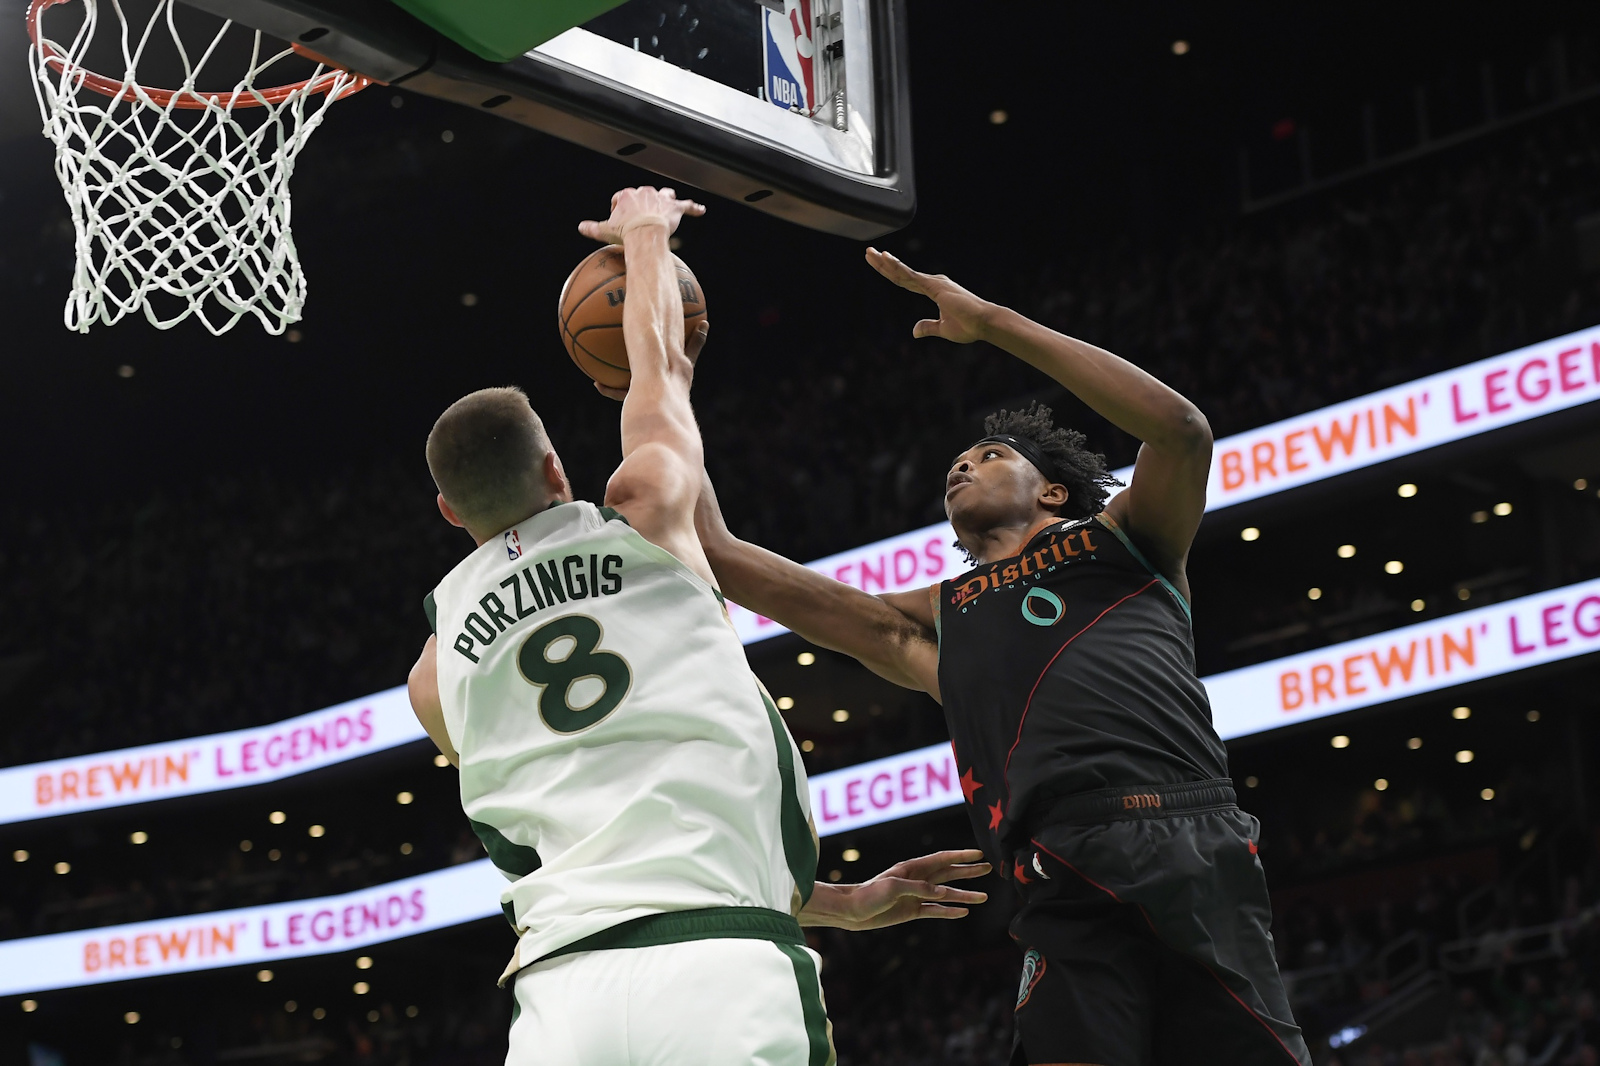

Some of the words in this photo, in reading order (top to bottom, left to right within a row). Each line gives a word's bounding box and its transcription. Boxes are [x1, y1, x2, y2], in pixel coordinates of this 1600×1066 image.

[773, 75, 798, 106] NBA
[1220, 393, 1429, 492] BREWIN'
[453, 554, 623, 664] PORZINGIS
[953, 528, 1098, 611] District
[1021, 586, 1066, 627] 0
[516, 613, 633, 736] 8
[1279, 622, 1488, 712] BREWIN'
[215, 709, 374, 777] LEGENDS
[263, 890, 425, 949] LEGENDS
